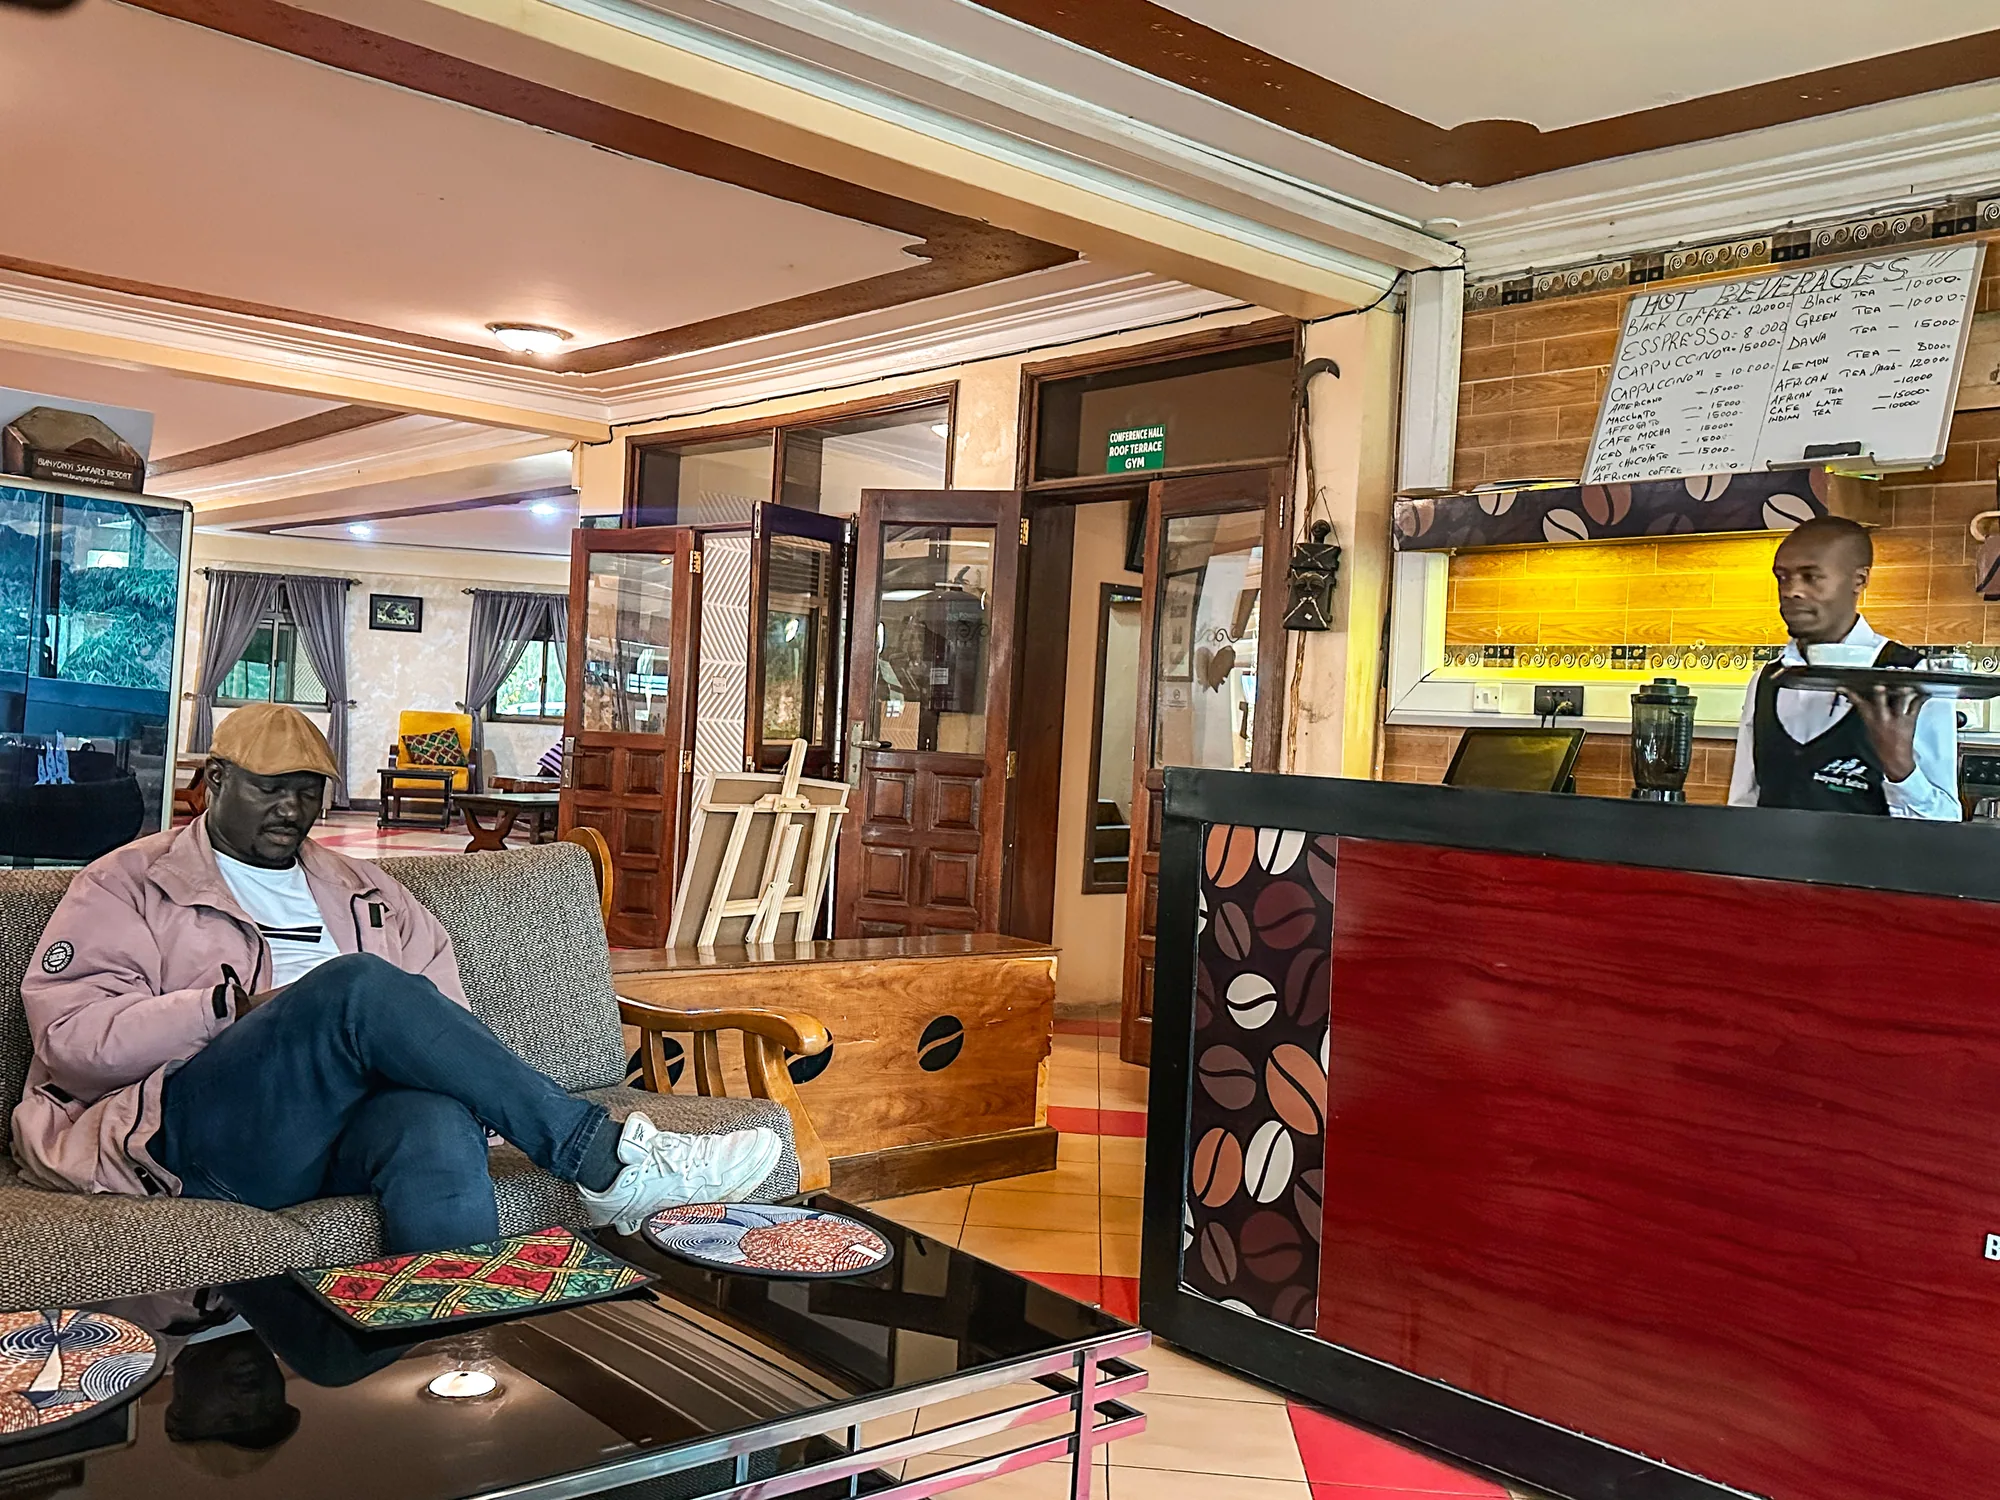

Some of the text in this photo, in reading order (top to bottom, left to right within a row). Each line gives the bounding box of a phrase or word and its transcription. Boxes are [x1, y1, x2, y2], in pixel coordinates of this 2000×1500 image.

[1640, 290, 1697, 316] HOT
[1712, 257, 1910, 306] BEVERAGES
[1851, 289, 1876, 299] TEA
[1795, 311, 1838, 328] GREEN
[1852, 305, 1881, 315] TEA
[1787, 332, 1827, 350] DAWA
[1850, 325, 1877, 335] TEA
[1782, 357, 1829, 372] LEMON
[1847, 350, 1880, 359] TEA
[1774, 373, 1829, 393] AFRICAN
[1839, 369, 1866, 378] TEA
[1771, 390, 1812, 405] AFRICAN
[1824, 387, 1844, 395] TEA
[1608, 396, 1662, 415] AMERICANO
[1769, 404, 1800, 415] CAFE
[1816, 398, 1844, 407] LATE
[1768, 413, 1800, 424] INDIAN
[1813, 409, 1832, 417] TEA
[1110, 427, 1164, 443] CONFERENCE HALL
[1598, 435, 1632, 450] CAFE
[1637, 428, 1671, 441] MOCHA
[1109, 441, 1162, 457] ROOF TERRACE
[1595, 450, 1622, 464] ICED
[1125, 456, 1145, 469] GYM
[1592, 463, 1613, 475] HOT
[51, 471, 115, 487] www.bunyonyi.com
[106, 468, 133, 481] RESORT
[1591, 472, 1640, 483] AFRICAN
[1648, 466, 1683, 476] COFFEE
